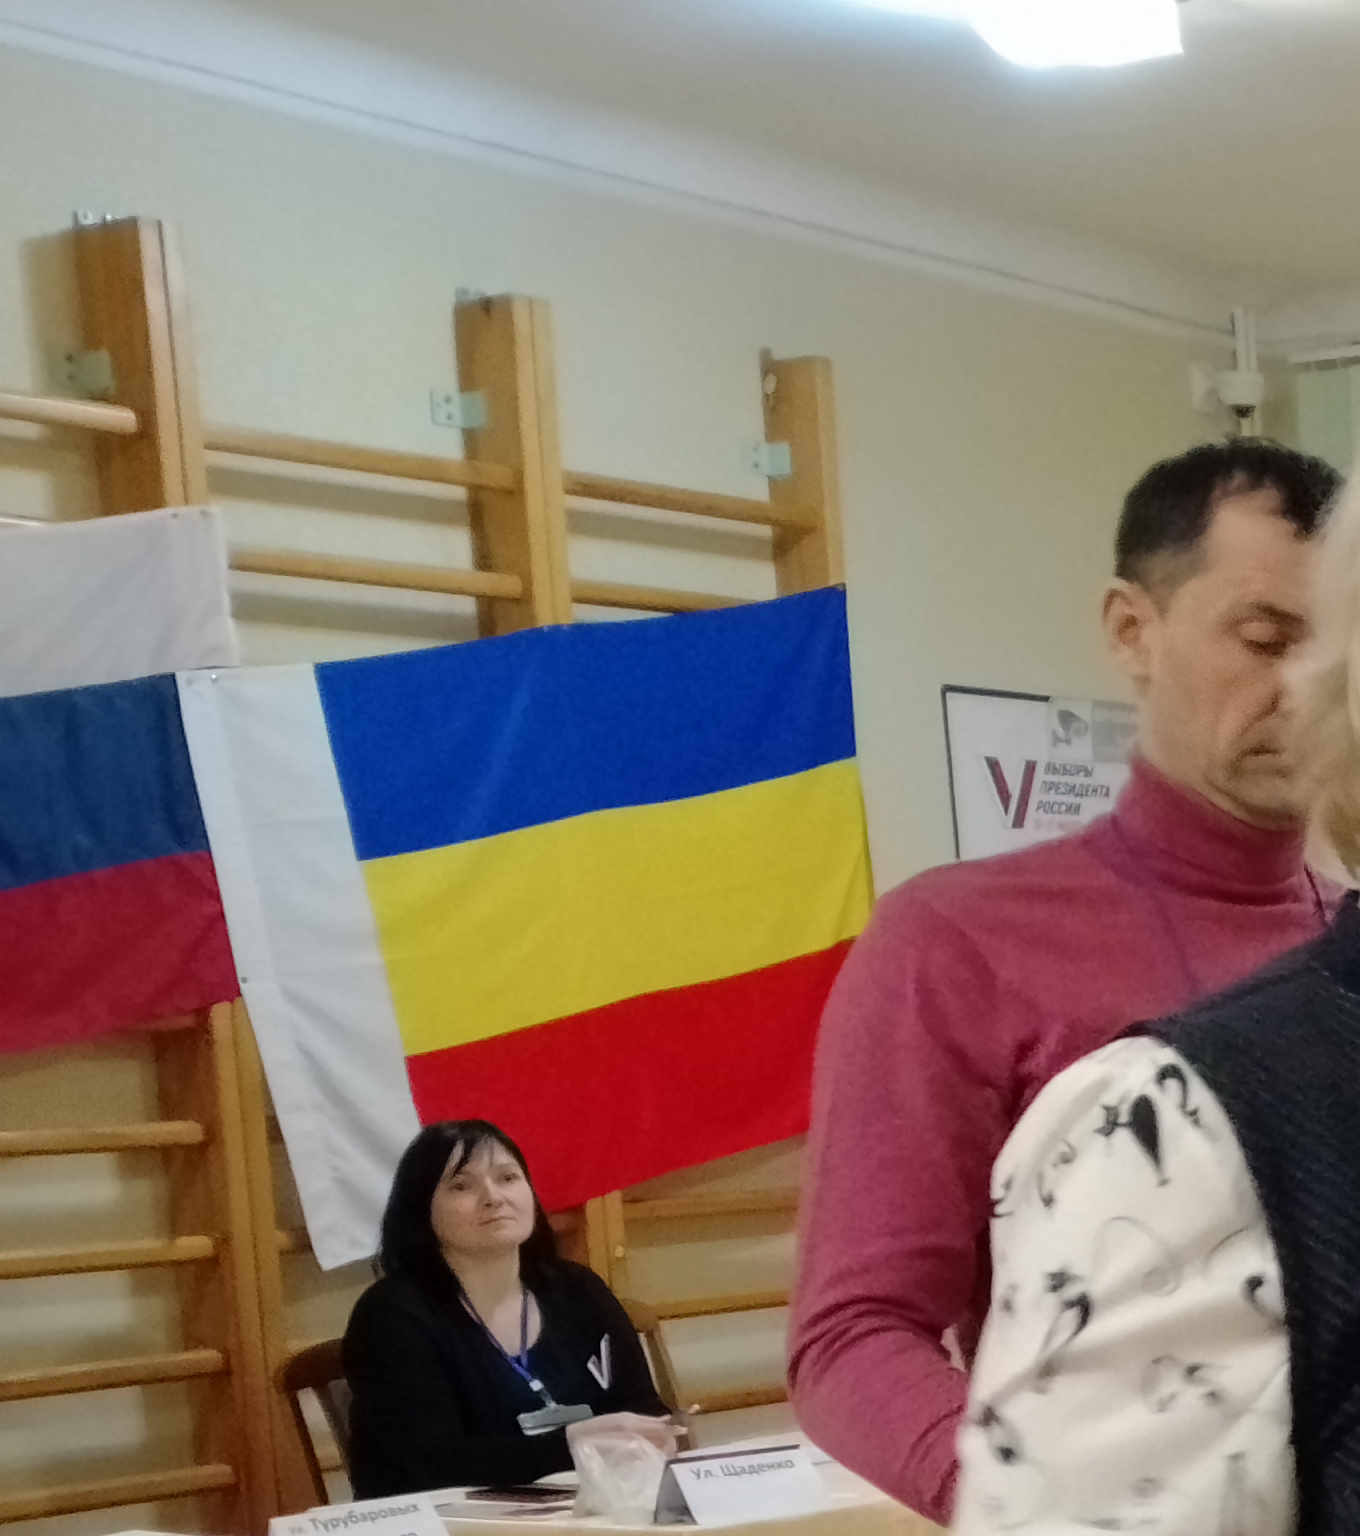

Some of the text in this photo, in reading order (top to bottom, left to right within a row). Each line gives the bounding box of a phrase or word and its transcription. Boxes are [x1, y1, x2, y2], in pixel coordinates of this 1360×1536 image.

[1044, 762, 1095, 778] ВЫБОРЫ
[1040, 781, 1110, 799] ПРЕЗИДЕНТА
[1036, 800, 1081, 816] РОССИИ
[720, 1459, 795, 1478] Щаденко
[308, 1503, 420, 1533] Турубаровых
